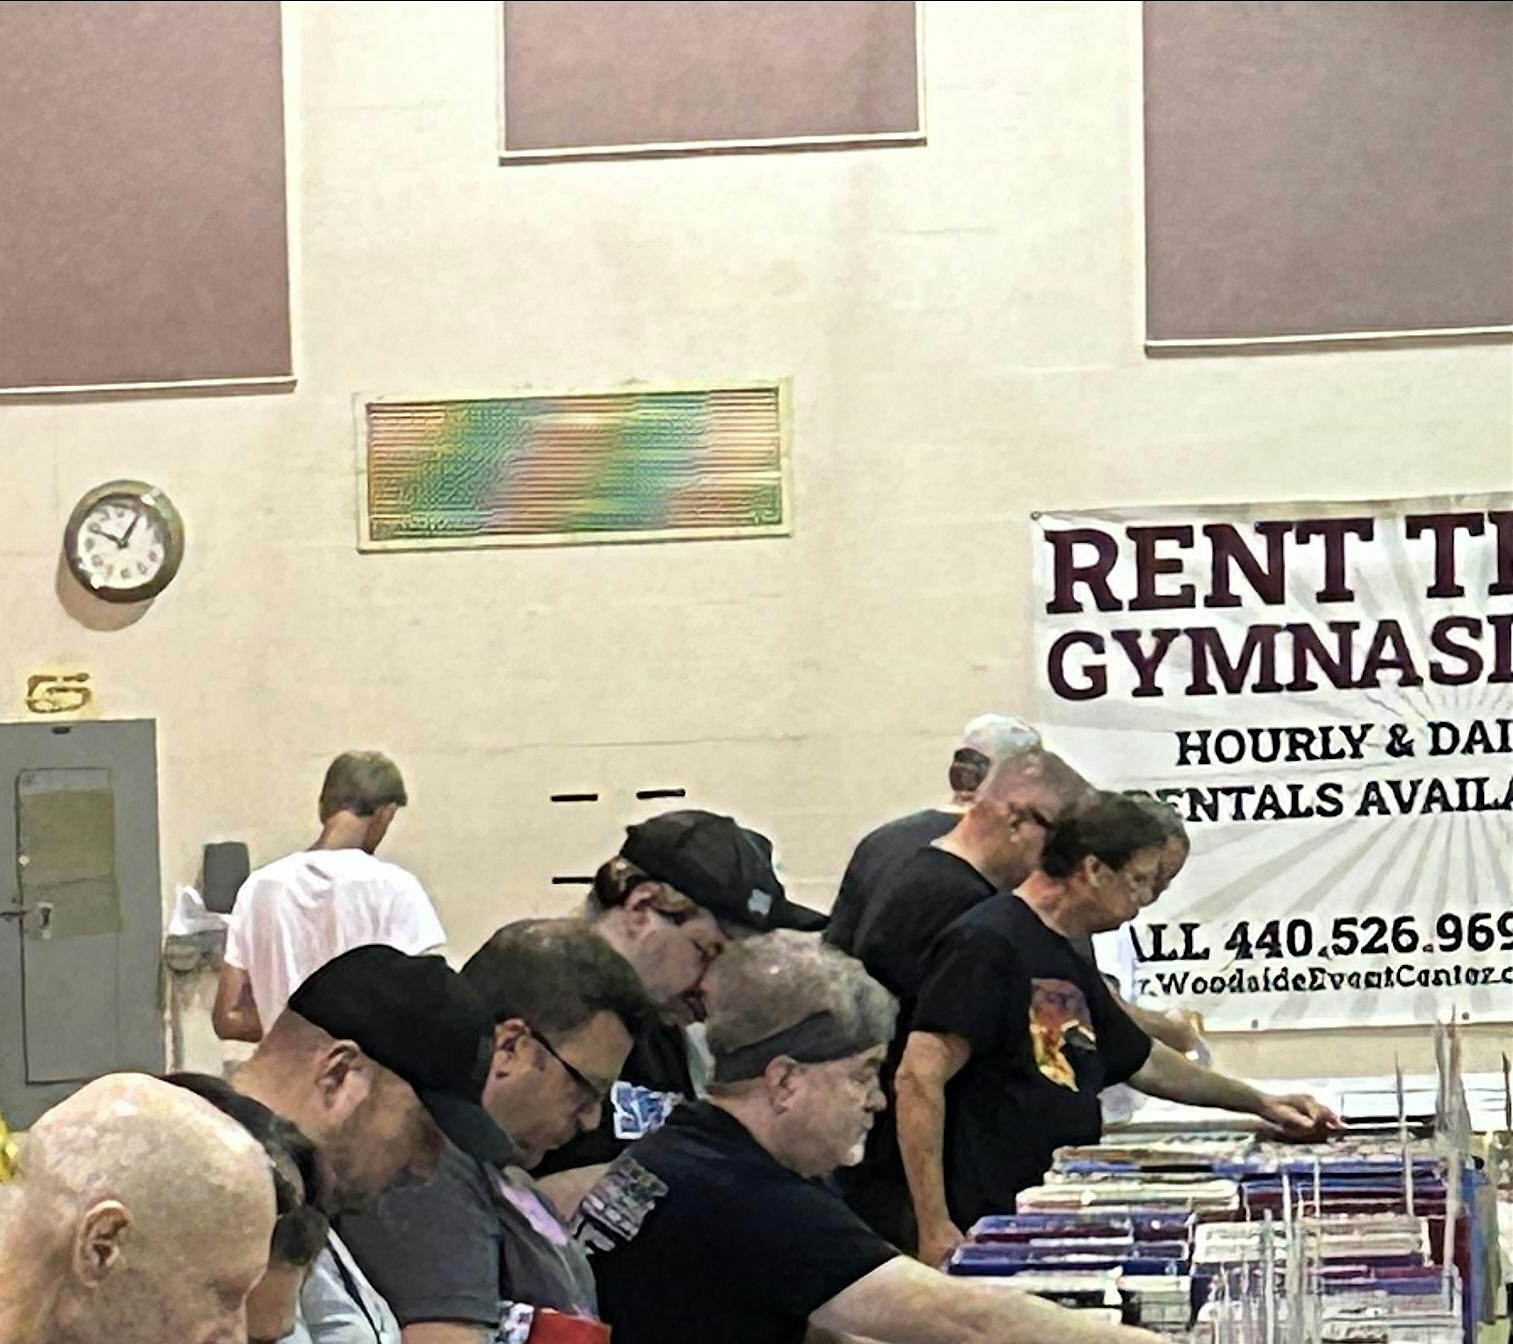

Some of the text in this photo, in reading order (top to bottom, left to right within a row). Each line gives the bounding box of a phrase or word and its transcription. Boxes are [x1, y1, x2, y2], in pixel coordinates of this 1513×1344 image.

[1044, 517, 1374, 615] RENT
[1047, 614, 1513, 701] GYMNASI
[1175, 718, 1513, 767] HOURLY & DAI
[1123, 783, 1345, 823] ENTALS
